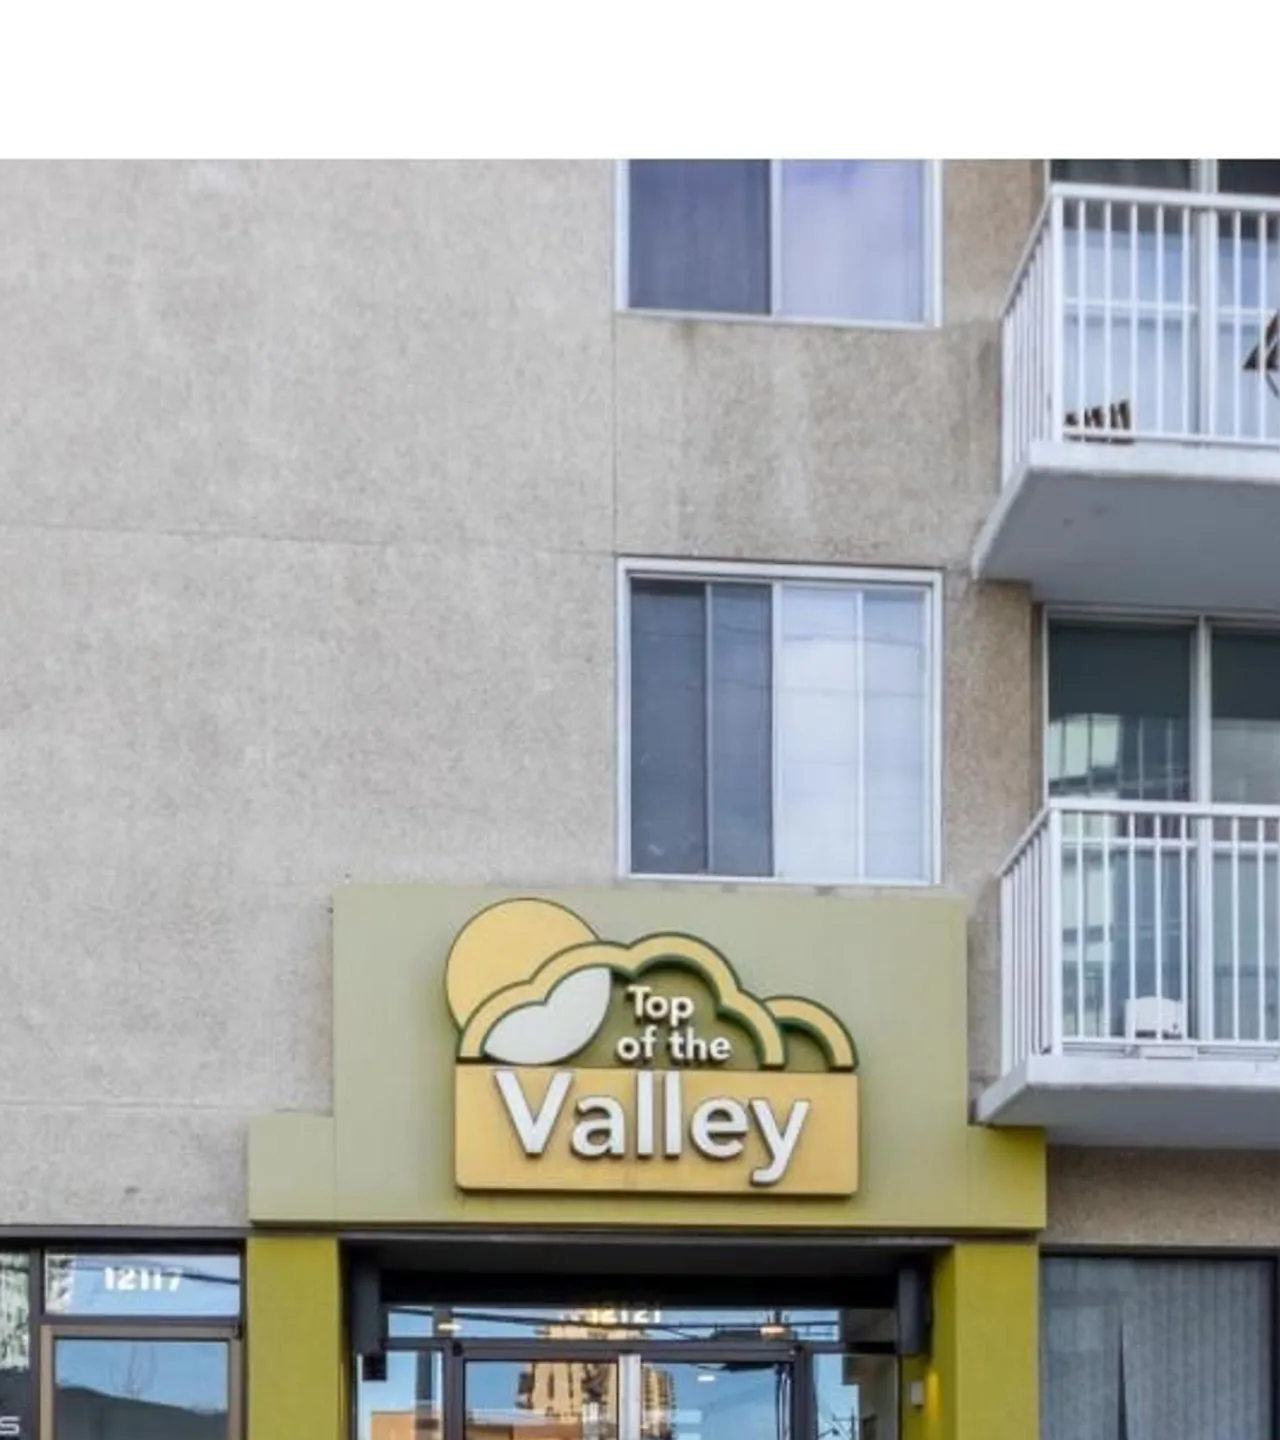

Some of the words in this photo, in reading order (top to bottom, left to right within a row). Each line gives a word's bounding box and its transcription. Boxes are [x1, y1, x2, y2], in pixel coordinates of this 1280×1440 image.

[624, 985, 695, 1026] Top
[616, 1024, 657, 1062] of
[669, 1028, 732, 1063] the
[494, 1070, 811, 1185] Valley
[104, 1266, 183, 1292] 12117
